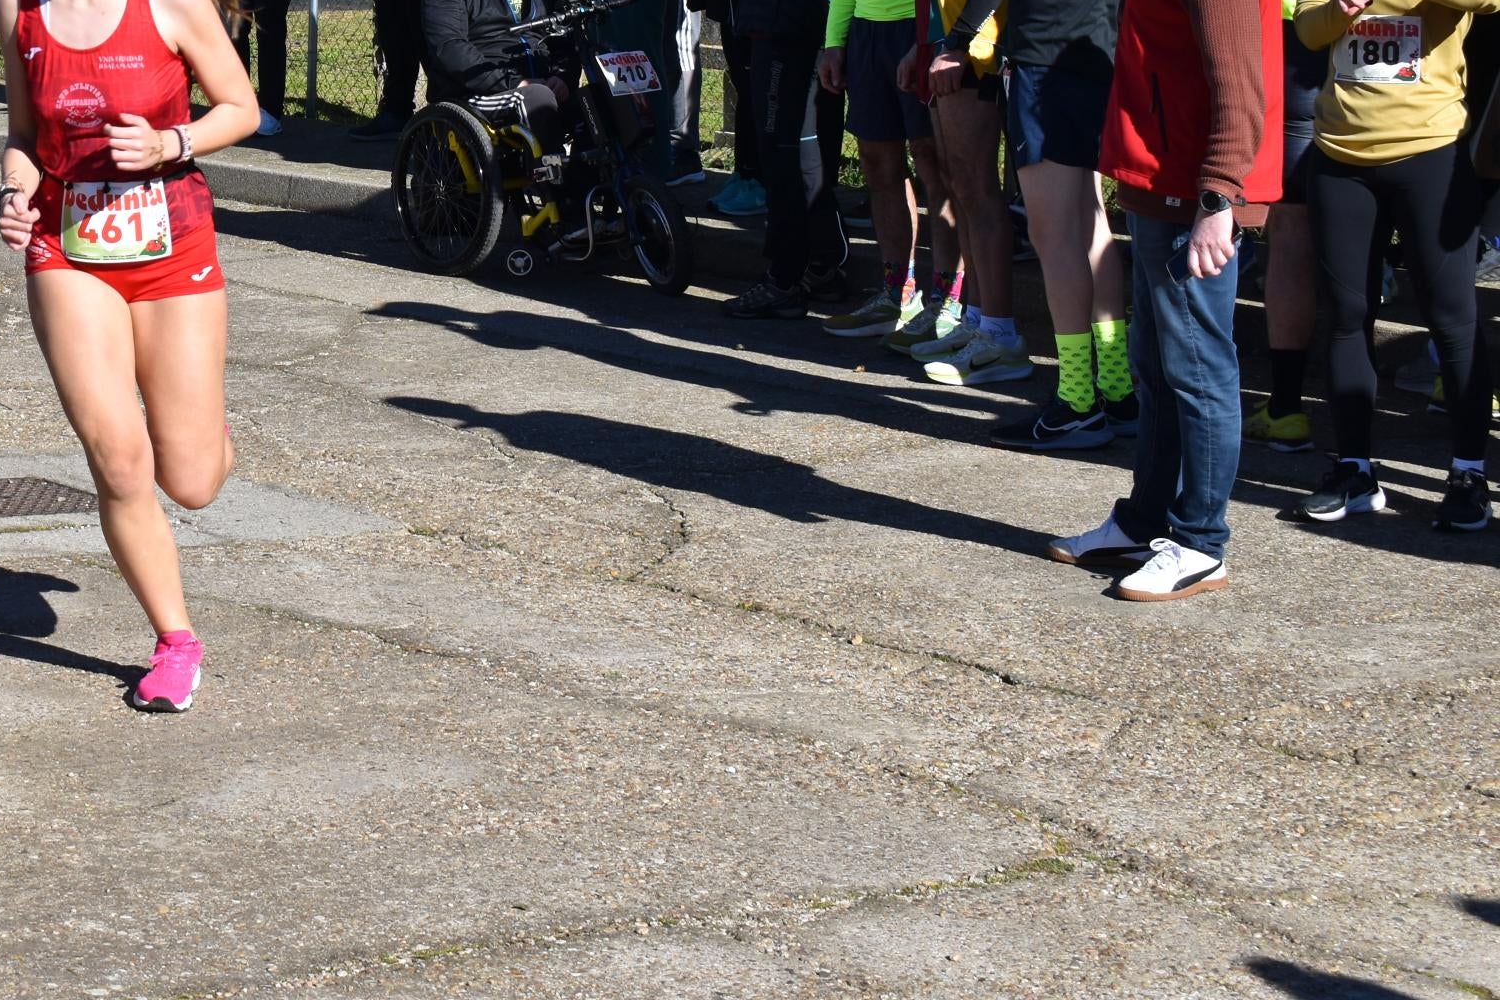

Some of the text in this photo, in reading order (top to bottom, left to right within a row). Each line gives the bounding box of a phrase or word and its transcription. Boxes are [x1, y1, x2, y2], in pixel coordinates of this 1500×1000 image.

[1348, 20, 1419, 38] dunia
[1348, 40, 1400, 66] 180
[617, 65, 647, 84] 410
[77, 211, 144, 244] 461
